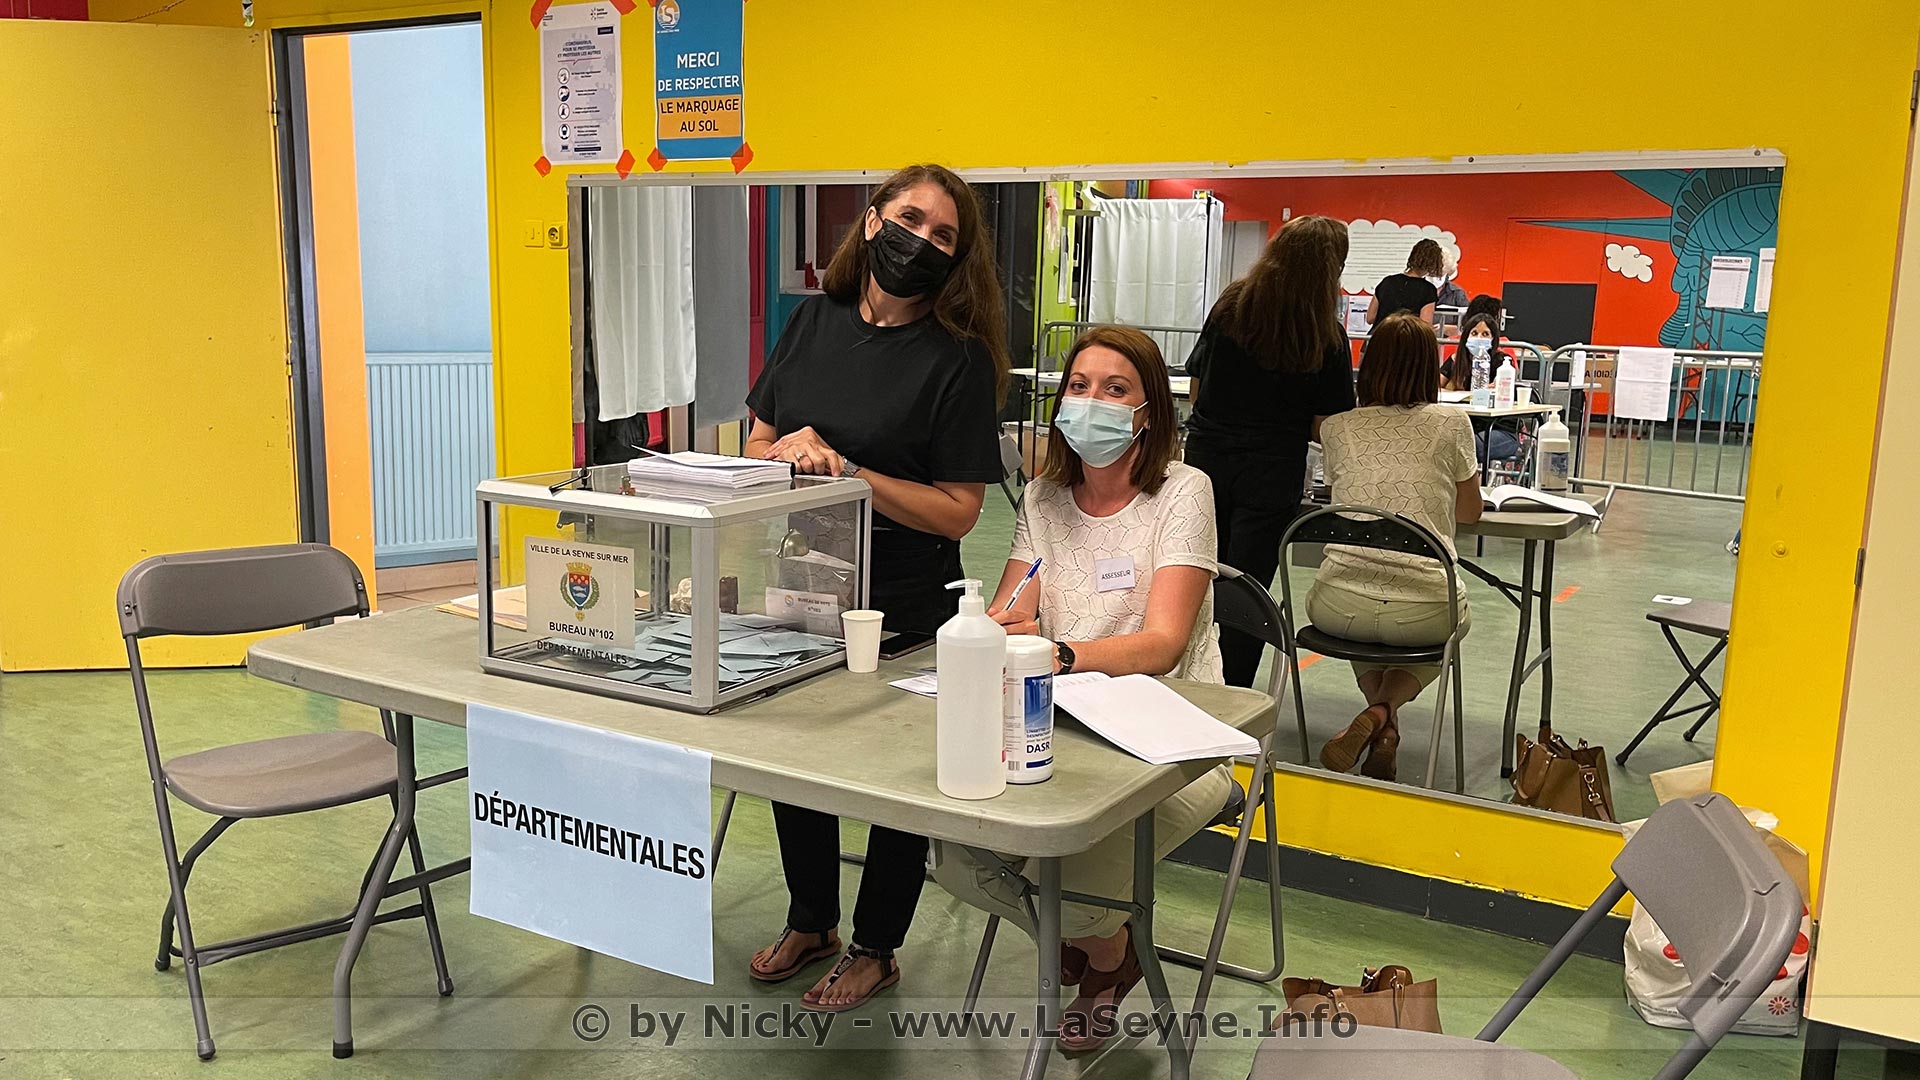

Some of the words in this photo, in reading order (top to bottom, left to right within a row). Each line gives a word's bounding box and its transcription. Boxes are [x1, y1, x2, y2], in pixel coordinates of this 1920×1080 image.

[677, 52, 719, 68] MERCI
[658, 80, 672, 91] DE
[676, 75, 739, 90] RESPECTER
[660, 102, 673, 113] LE
[677, 99, 739, 114] MARQUAGE
[680, 121, 695, 132] AU
[698, 120, 719, 131] SOL
[530, 544, 549, 553] VILLE
[562, 548, 571, 556] LA
[572, 550, 595, 559] SEYNE
[597, 552, 611, 561] SUR
[613, 555, 628, 563] MER
[1102, 570, 1131, 580] ASSESSEUR
[549, 622, 586, 636] BUREAU
[589, 628, 614, 640] N°102
[1026, 741, 1050, 753] DASR
[474, 790, 705, 879] DÉPARTEMENTALES
